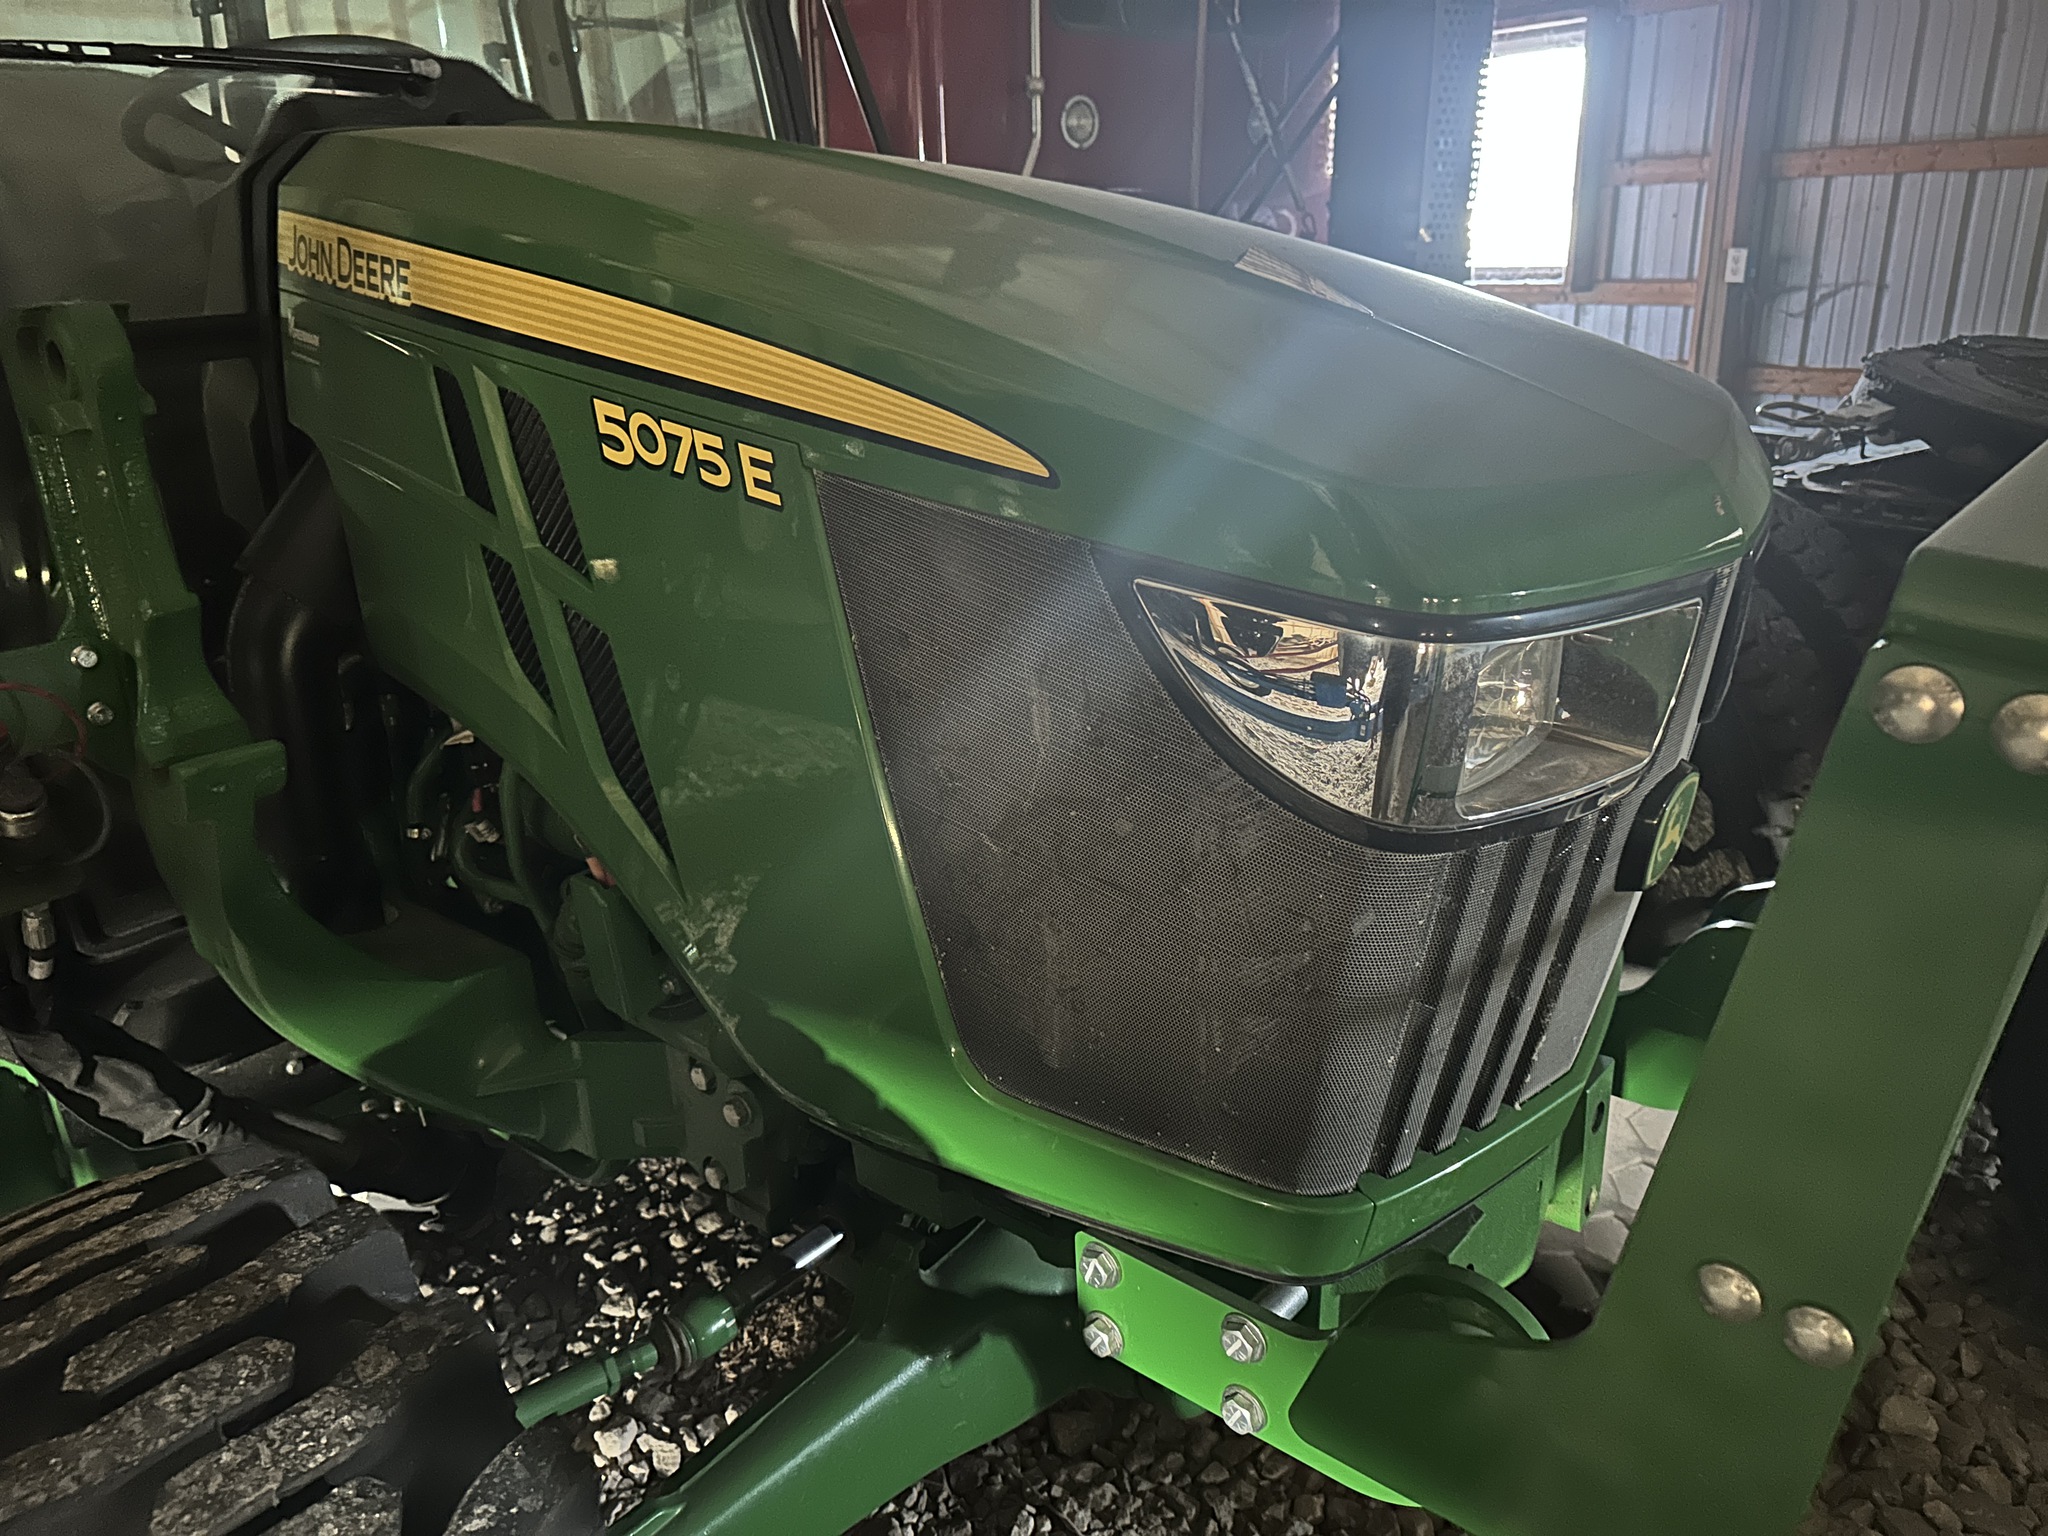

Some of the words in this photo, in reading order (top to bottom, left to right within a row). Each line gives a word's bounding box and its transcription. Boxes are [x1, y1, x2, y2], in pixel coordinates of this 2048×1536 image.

[289, 225, 332, 279] JOHN
[337, 236, 411, 301] DEERE
[593, 397, 731, 488] 5075
